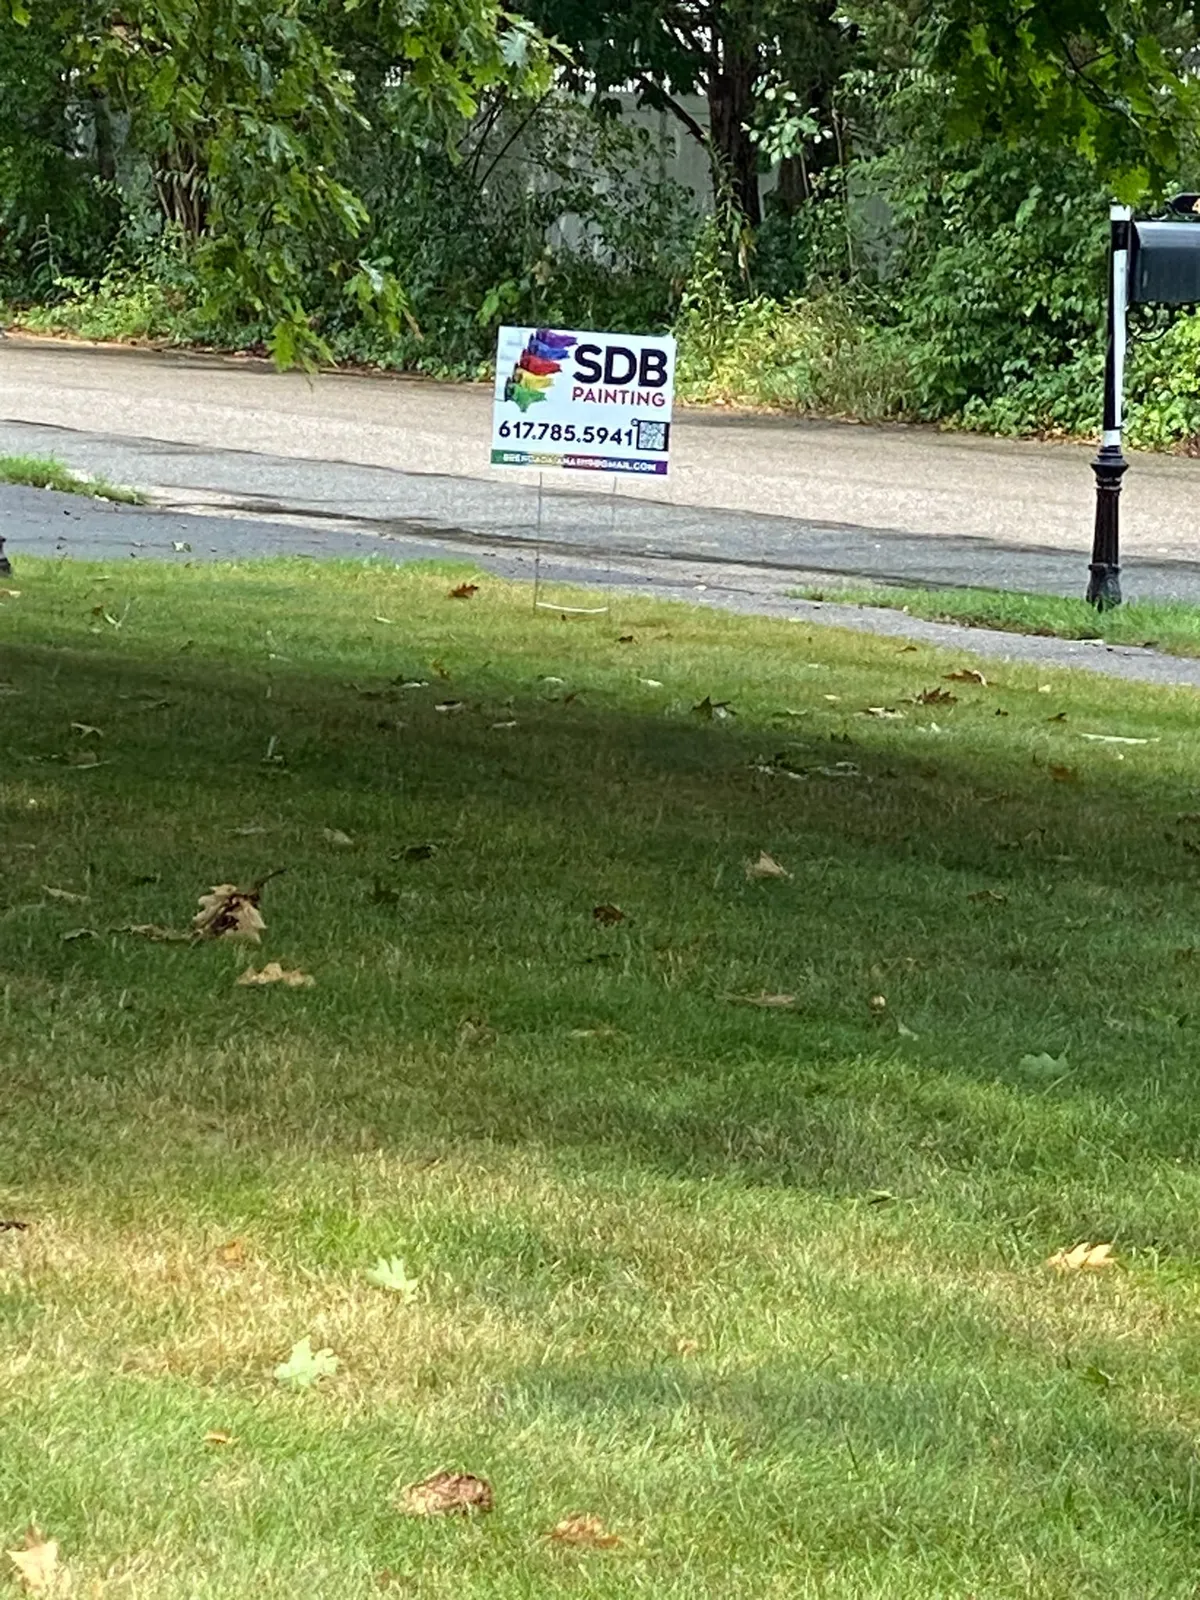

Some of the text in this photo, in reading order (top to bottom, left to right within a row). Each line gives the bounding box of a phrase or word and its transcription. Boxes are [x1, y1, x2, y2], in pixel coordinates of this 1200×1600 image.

[572, 344, 668, 388] SDB
[572, 386, 666, 407] PAINTING
[498, 420, 633, 446] 617.785.5941
